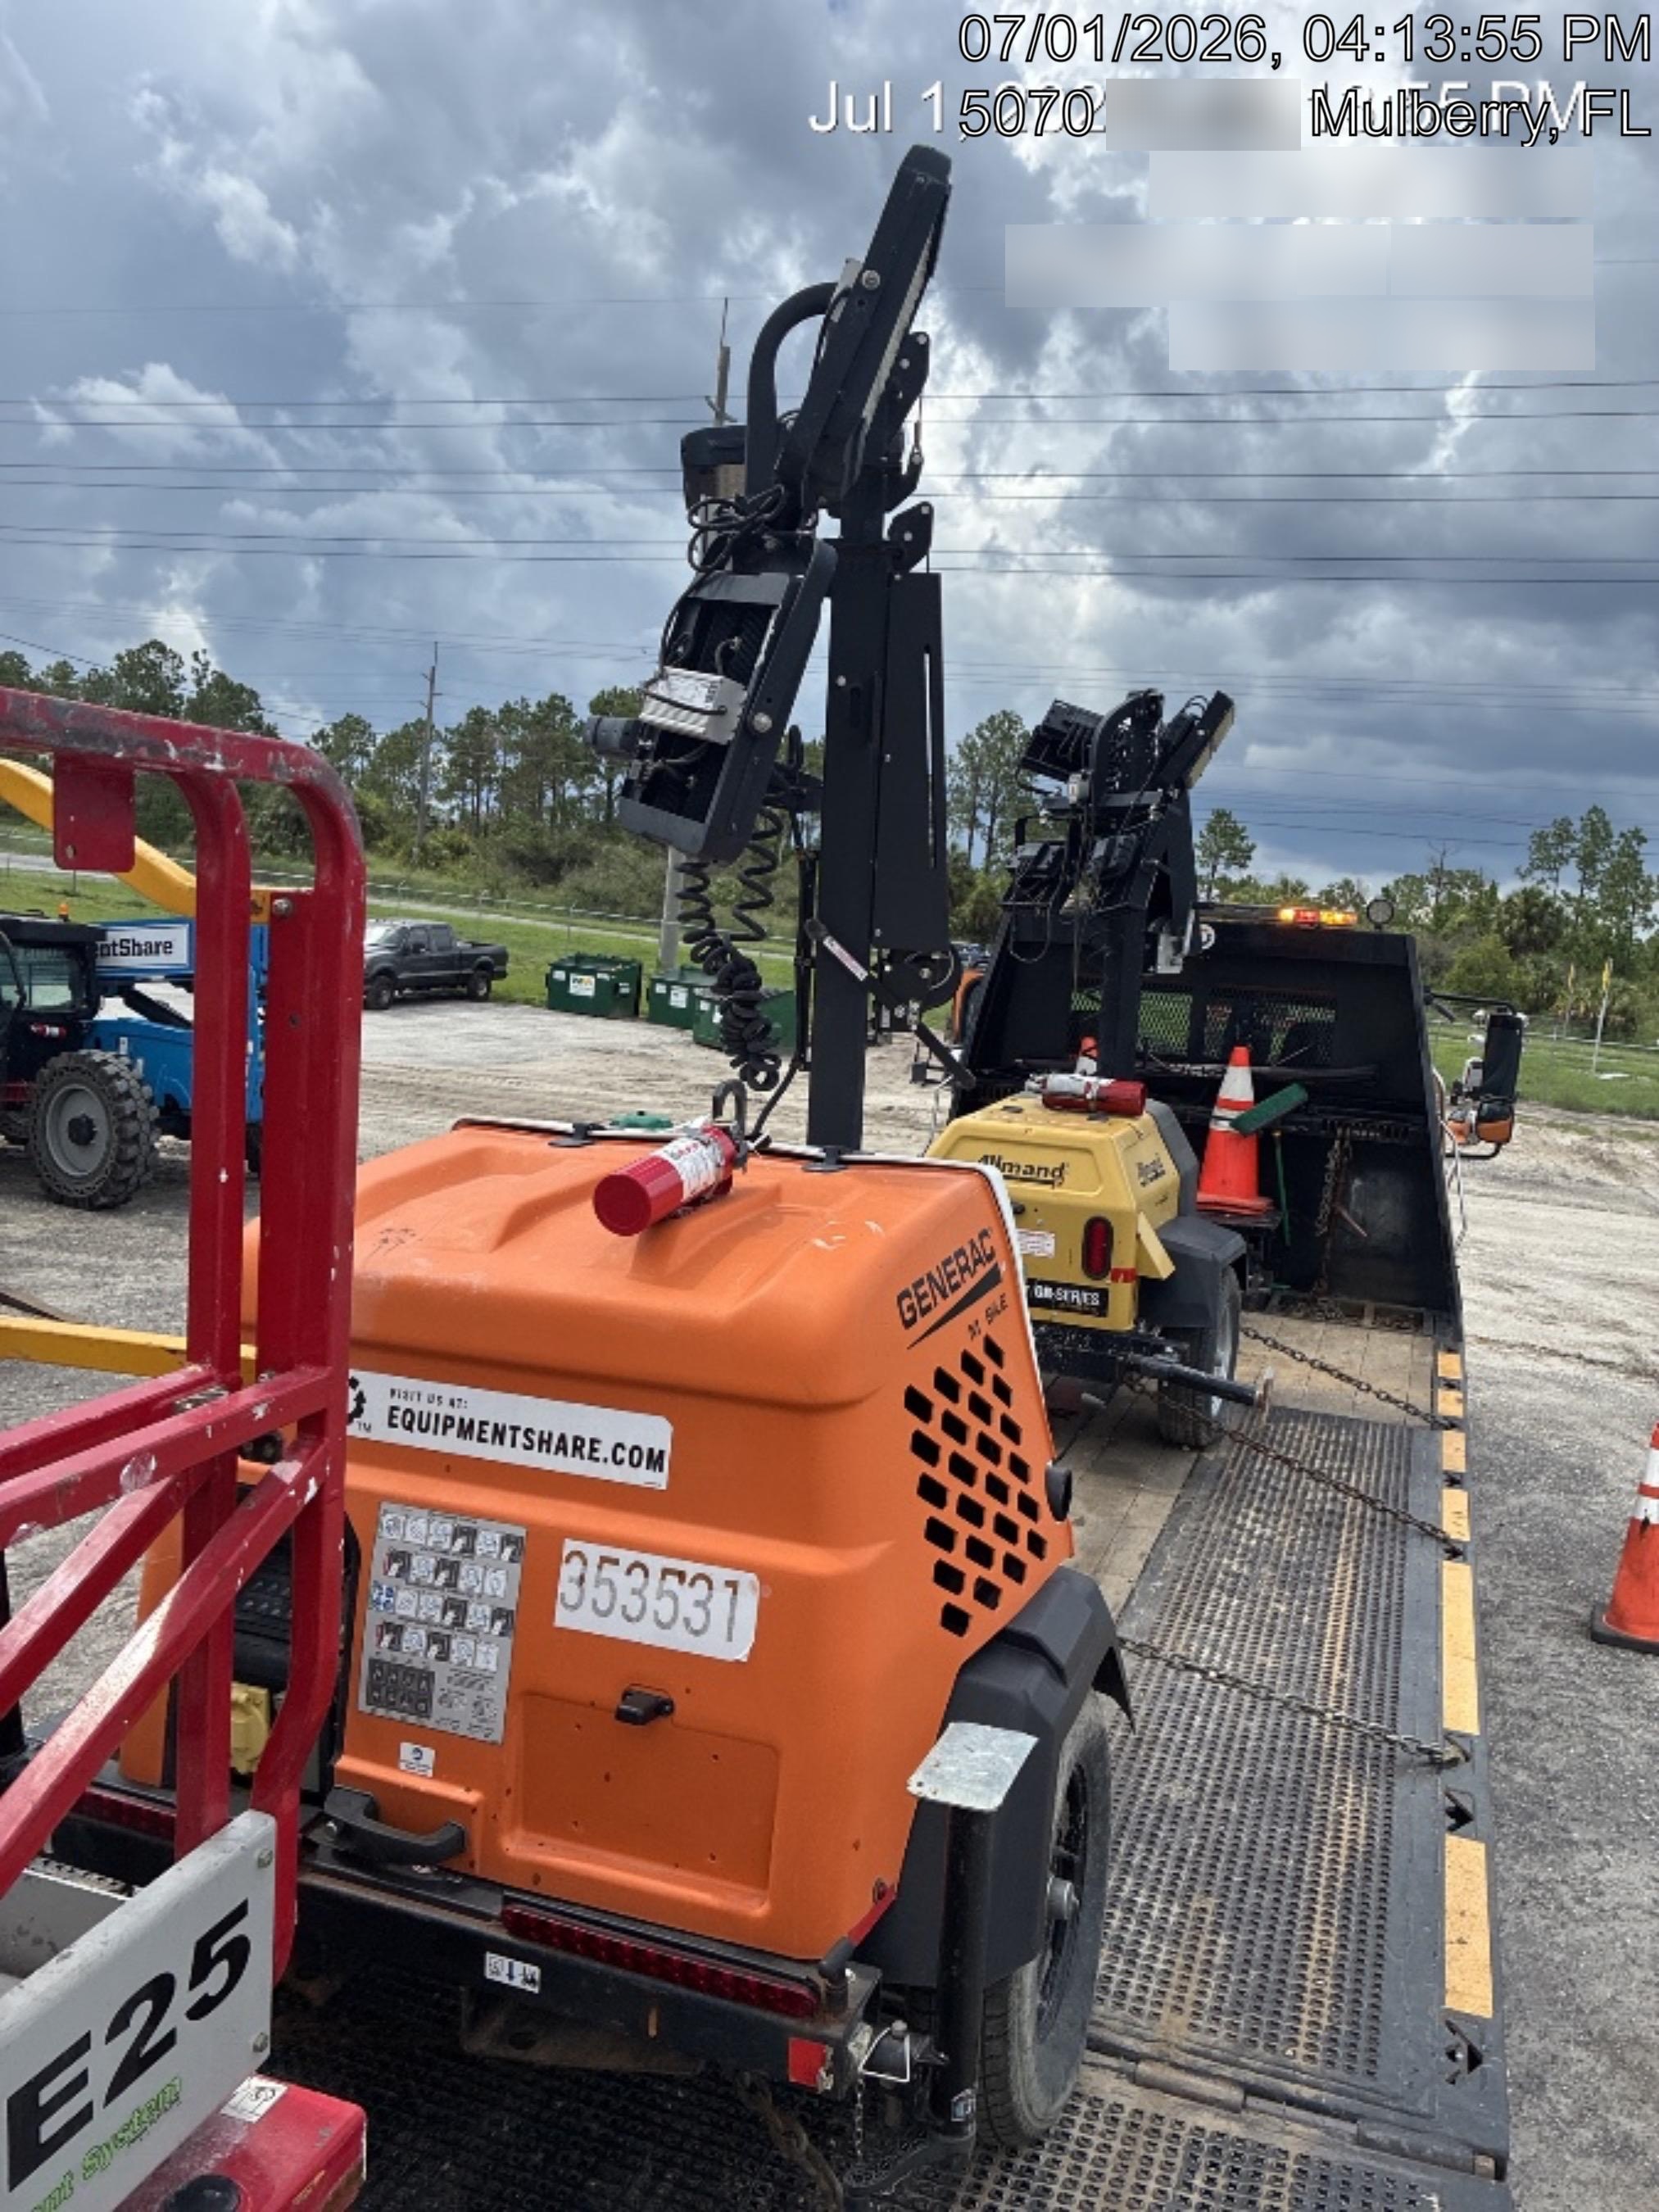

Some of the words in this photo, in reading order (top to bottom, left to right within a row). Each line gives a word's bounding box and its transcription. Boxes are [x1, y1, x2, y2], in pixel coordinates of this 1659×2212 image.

[97, 938, 173, 957] ntShare
[897, 1227, 996, 1330] GENERAC
[390, 1388, 421, 1403] VISIT
[427, 1394, 443, 1407] US
[388, 1405, 665, 1473] EQUIPMENTSHARE.COM
[560, 1549, 740, 1643] 353531
[7, 1897, 252, 2193] E25
